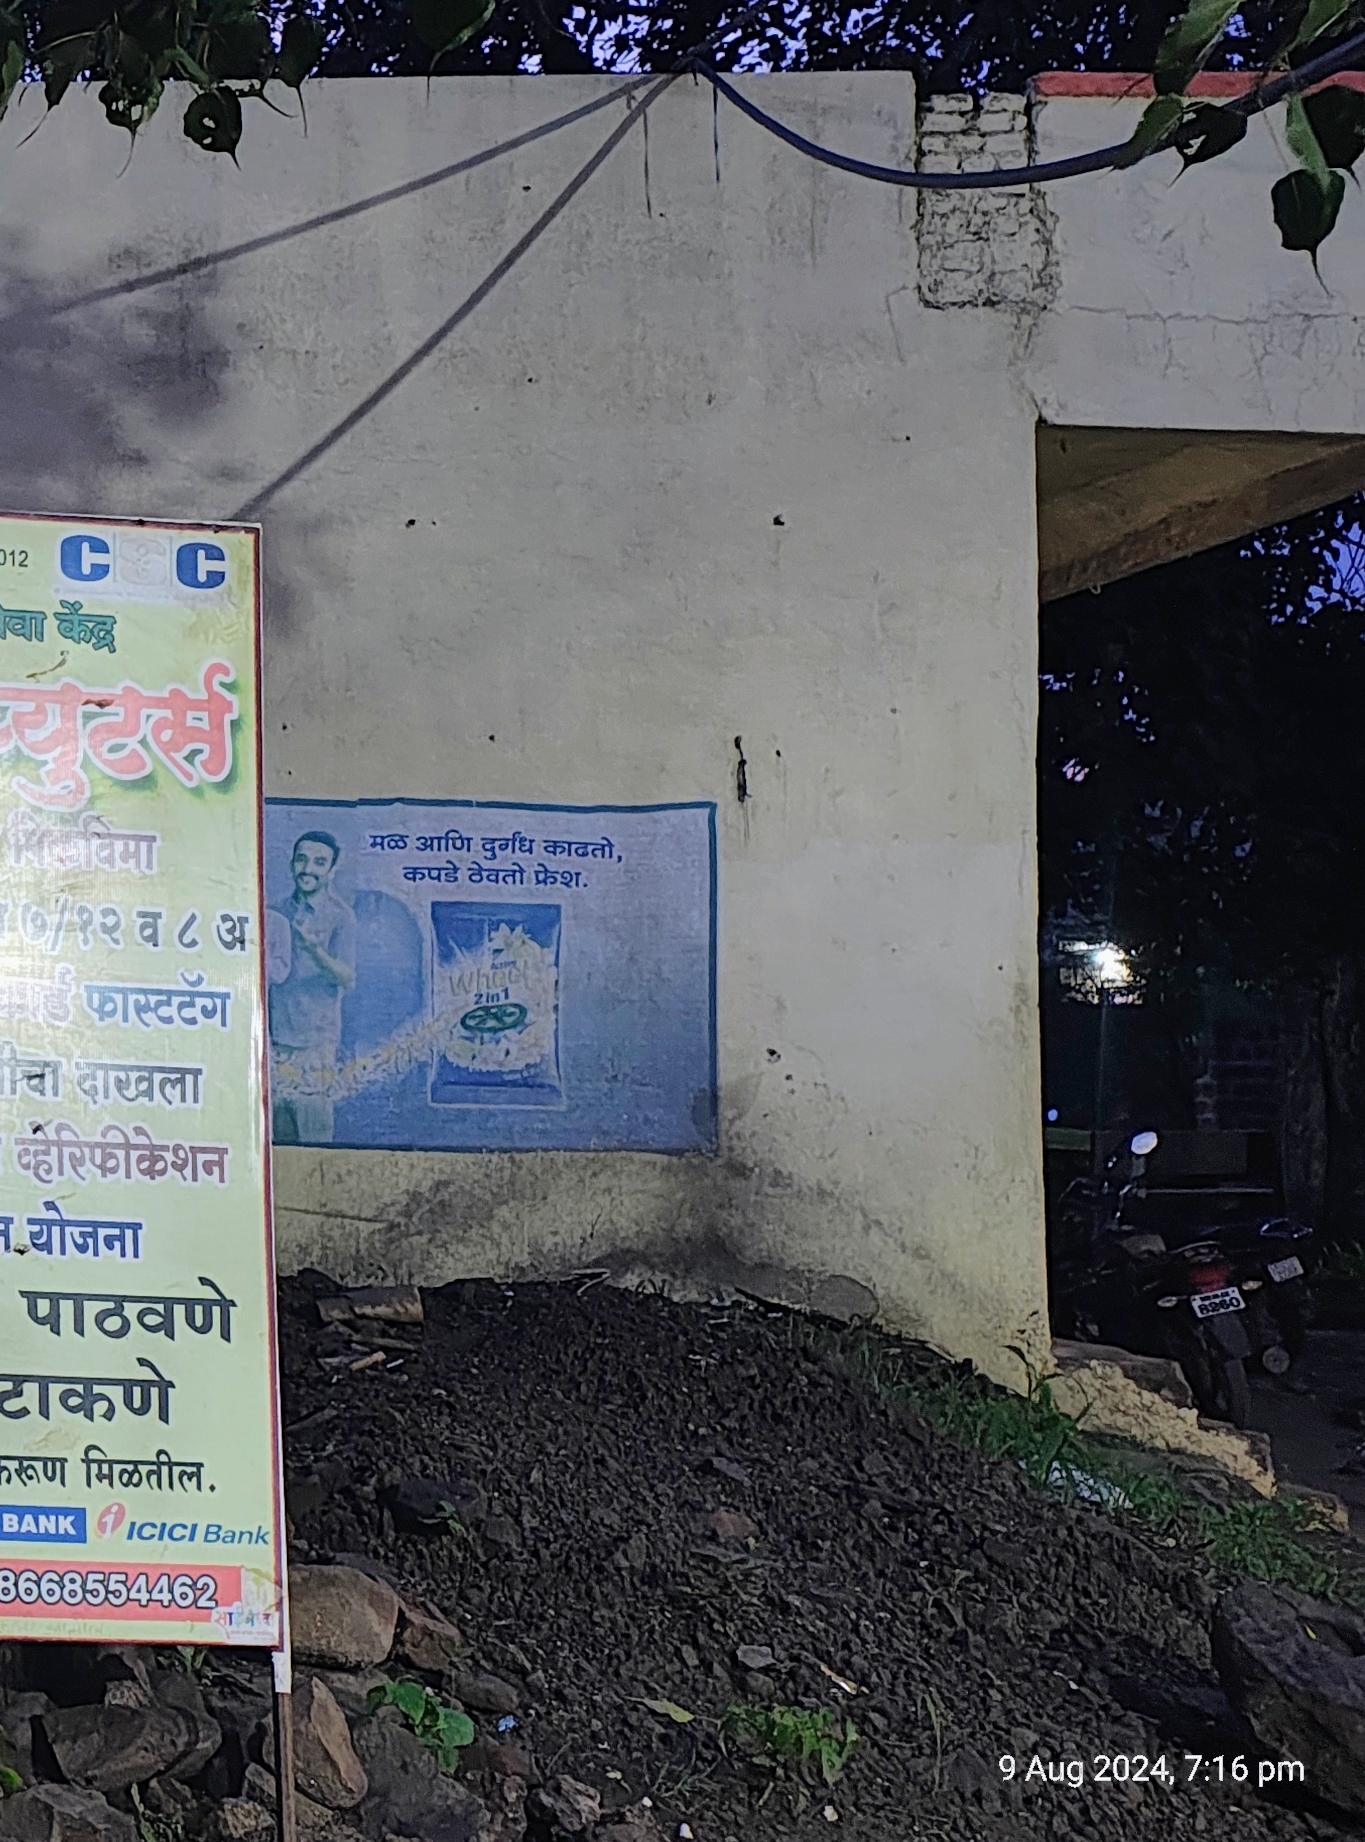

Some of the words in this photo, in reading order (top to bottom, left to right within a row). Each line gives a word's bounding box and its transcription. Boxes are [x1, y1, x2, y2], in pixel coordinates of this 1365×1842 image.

[55, 601, 116, 652] केंद्र
[369, 833, 409, 852] मळ
[415, 829, 474, 855] आणि
[543, 835, 623, 864] काढतो,
[402, 861, 459, 885] कपडे
[468, 863, 526, 887] ठेवतो
[136, 909, 162, 951] व
[177, 913, 200, 950] ८
[215, 911, 249, 954] अ
[74, 1058, 202, 1106] दाखला
[26, 1201, 142, 1261] योजना
[20, 1276, 238, 1344] पाठवणे
[82, 1446, 217, 1493] मिळतील.
[2, 1511, 77, 1535] BANK
[126, 1522, 197, 1544] ICICI
[203, 1524, 270, 1547] Bank
